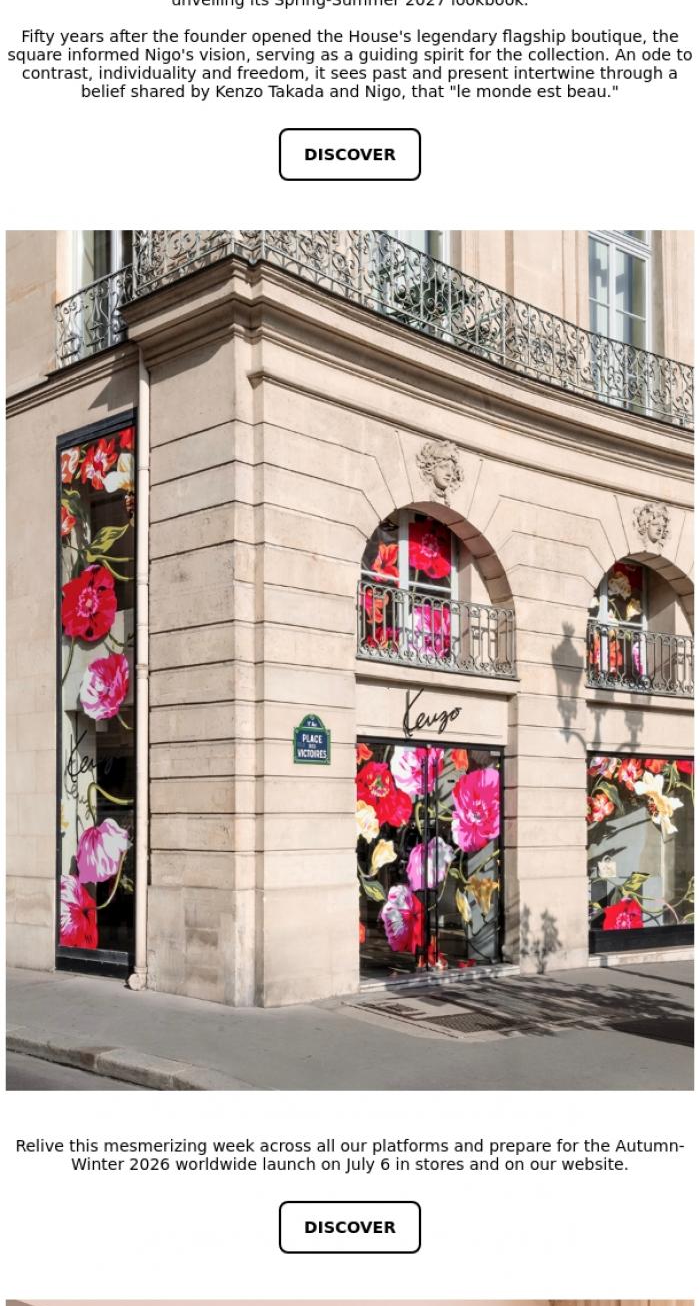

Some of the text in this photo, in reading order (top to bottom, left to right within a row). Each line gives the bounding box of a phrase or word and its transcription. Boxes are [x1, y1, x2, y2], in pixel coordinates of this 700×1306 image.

[403, 688, 463, 737] Kenzo
[302, 733, 323, 744] PLACE
[297, 748, 327, 759] VICTOIRES
